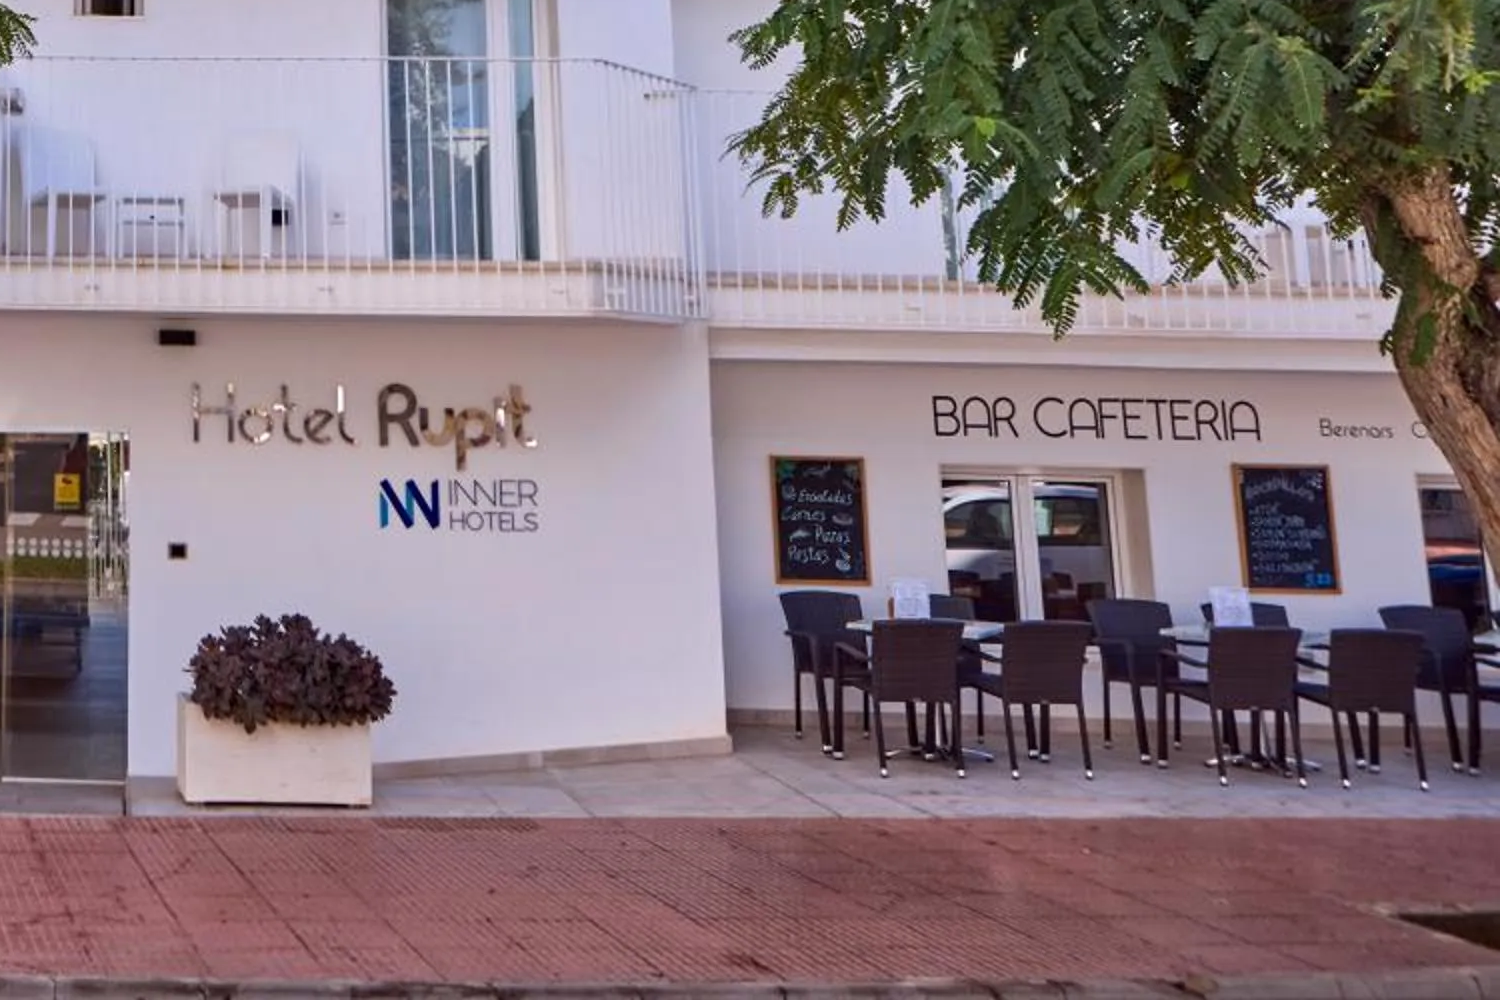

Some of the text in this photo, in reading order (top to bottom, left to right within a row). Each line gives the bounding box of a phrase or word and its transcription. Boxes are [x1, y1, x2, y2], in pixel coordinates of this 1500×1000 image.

[193, 382, 539, 471] Hotel Rupit
[932, 396, 1262, 441] BAR CAFETERIA
[448, 479, 539, 507] INNER
[449, 511, 539, 532] HOTELS
